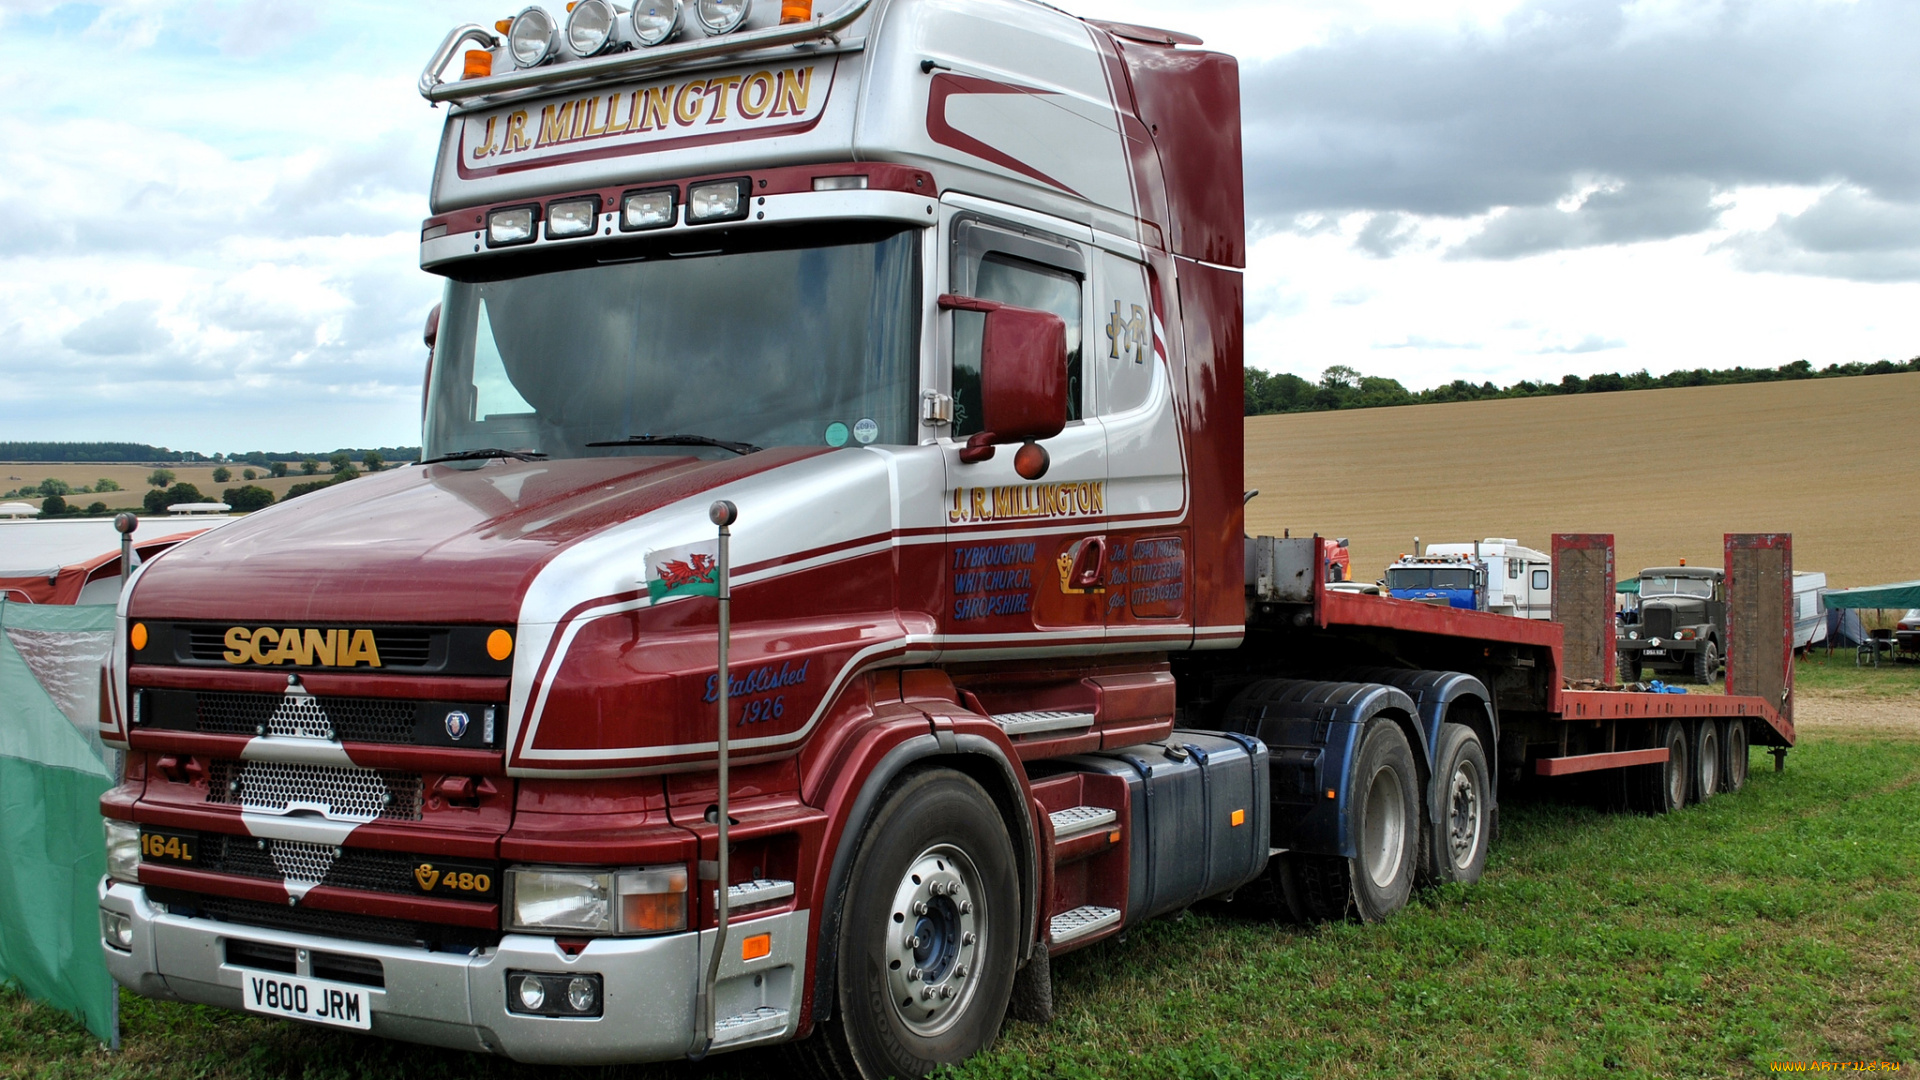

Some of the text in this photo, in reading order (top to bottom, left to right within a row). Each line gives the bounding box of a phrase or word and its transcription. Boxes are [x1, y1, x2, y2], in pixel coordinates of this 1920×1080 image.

[534, 66, 815, 149] MILLINGTON
[991, 481, 1104, 521] MILLINGTON
[223, 627, 381, 668] SCANIA
[703, 659, 810, 703] Etablished
[738, 696, 784, 727] 1926
[141, 833, 193, 860] 164L
[442, 871, 491, 893] 480
[252, 977, 361, 1022] V800 JRM
